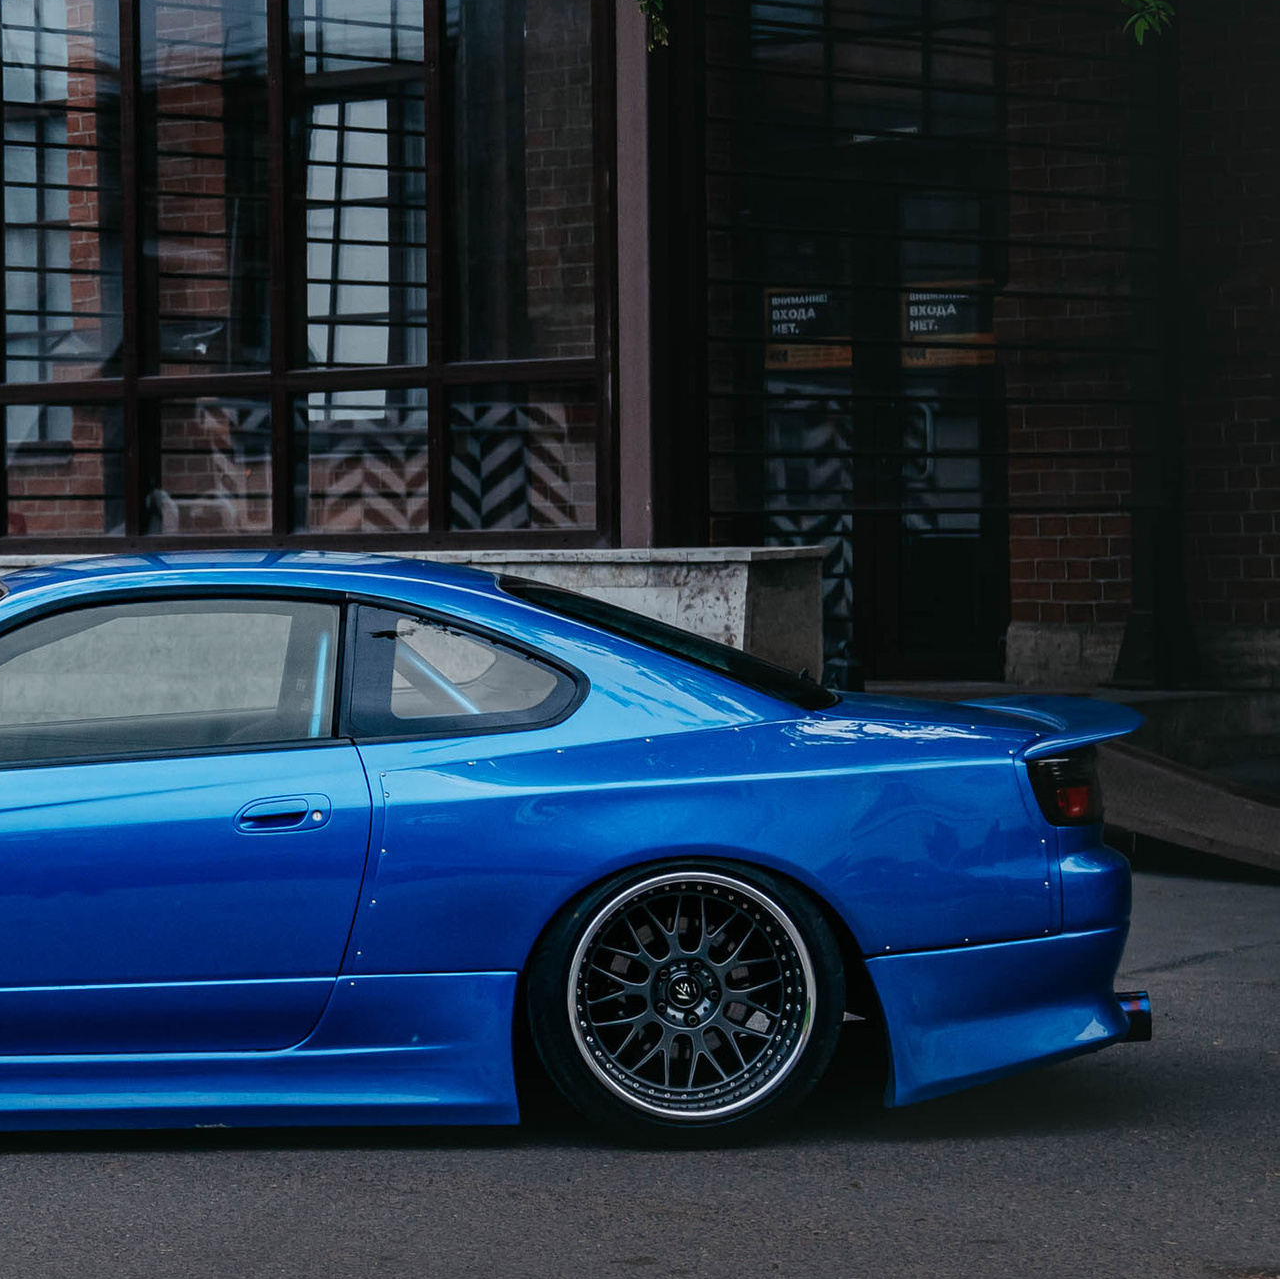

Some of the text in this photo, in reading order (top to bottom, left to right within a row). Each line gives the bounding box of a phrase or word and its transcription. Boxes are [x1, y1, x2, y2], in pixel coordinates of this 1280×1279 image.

[772, 307, 816, 321] ВХОДА
[909, 303, 956, 317] ВХОДА
[772, 322, 799, 335] НЕТ.
[909, 319, 938, 332] НЕТ.
